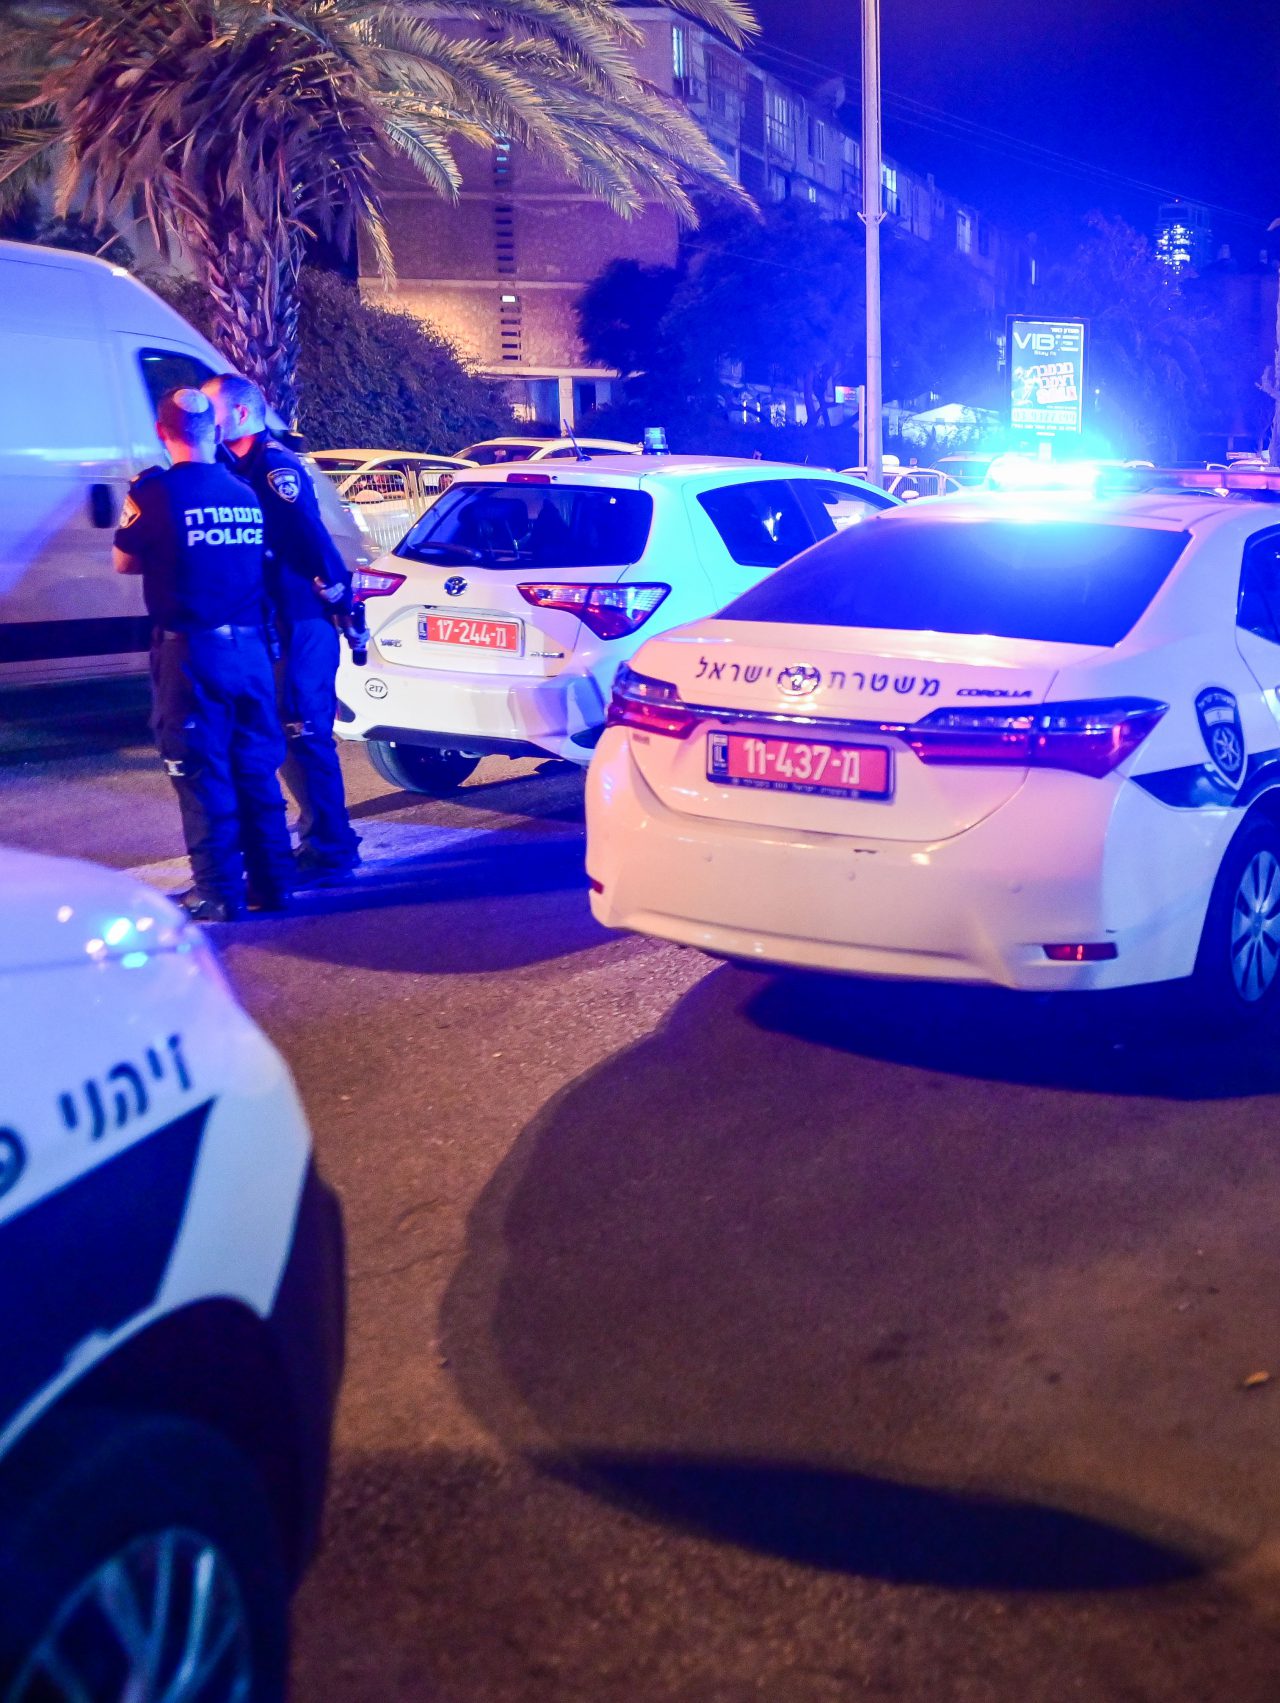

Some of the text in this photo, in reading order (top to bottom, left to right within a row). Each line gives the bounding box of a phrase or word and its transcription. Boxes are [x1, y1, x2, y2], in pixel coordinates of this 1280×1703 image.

[1013, 332, 1080, 352] VIBE
[184, 507, 263, 526] משטרה
[187, 528, 263, 547] POLICE
[695, 656, 941, 697] משטרת ישראל
[957, 688, 1034, 699] COROLLA
